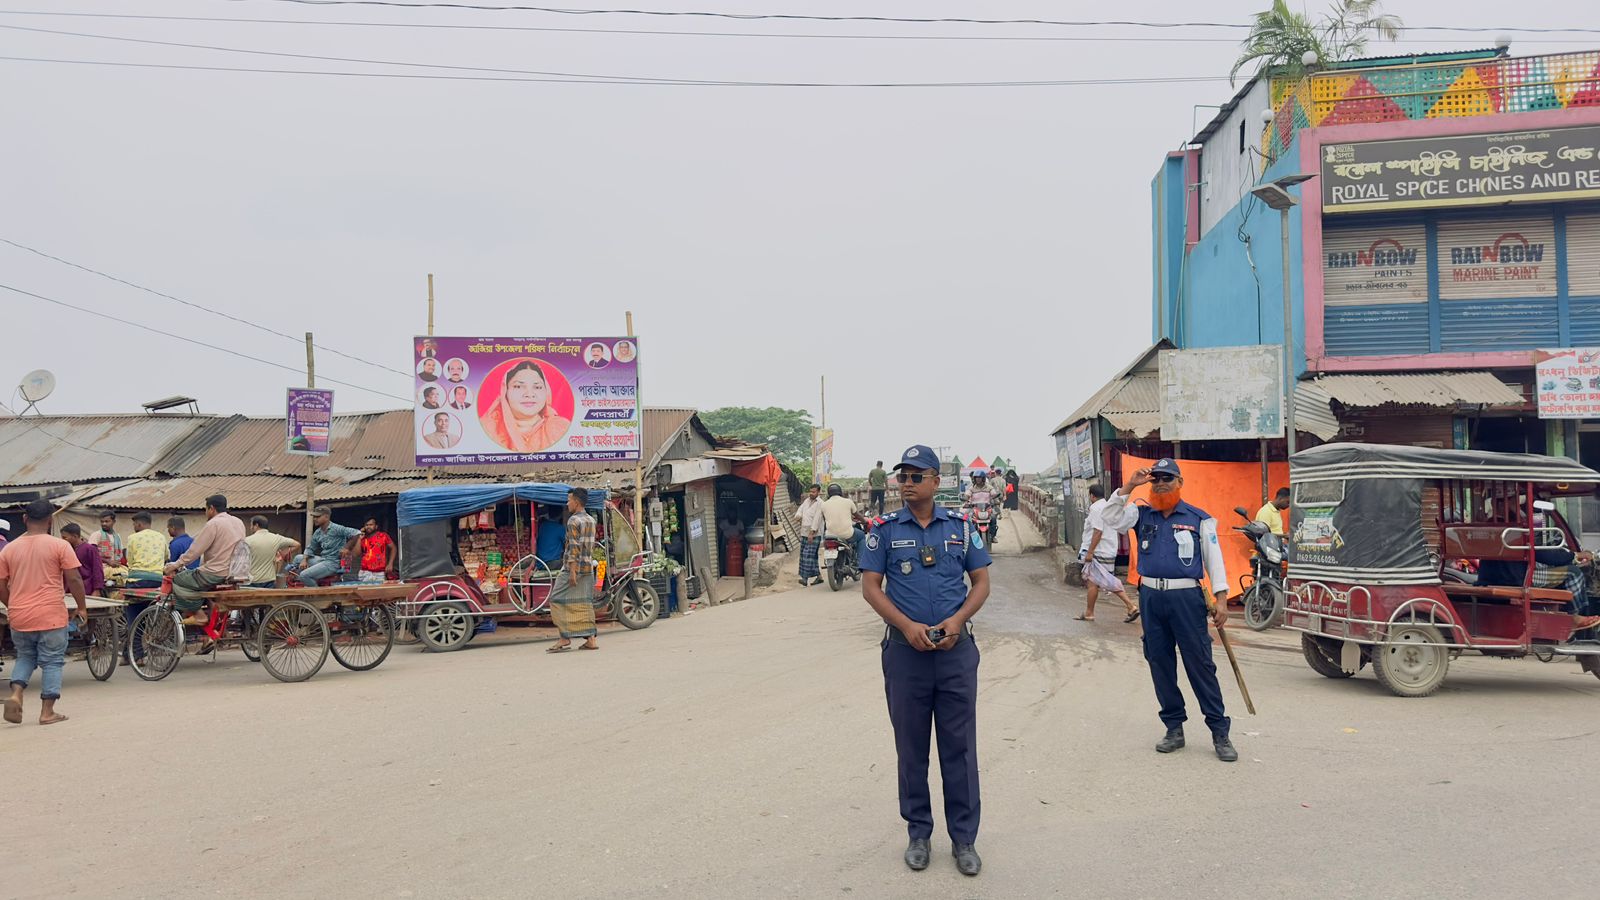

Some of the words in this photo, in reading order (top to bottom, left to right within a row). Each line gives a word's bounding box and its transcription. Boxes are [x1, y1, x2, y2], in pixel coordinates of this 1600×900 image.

[1332, 182, 1389, 204] ROYAL
[1530, 171, 1570, 189] AND
[1328, 246, 1417, 268] RAINBOW
[1451, 243, 1544, 264] RAINBOW
[1374, 269, 1412, 278] PAINTS
[1452, 267, 1500, 282] MARINE
[1504, 265, 1540, 280] PAINT
[578, 382, 607, 397] পারভীন
[609, 385, 635, 396] আক্তার
[590, 409, 630, 419] পদপ্রার্থী
[446, 455, 475, 463] জাজিরা
[478, 454, 518, 462] উপজেলার
